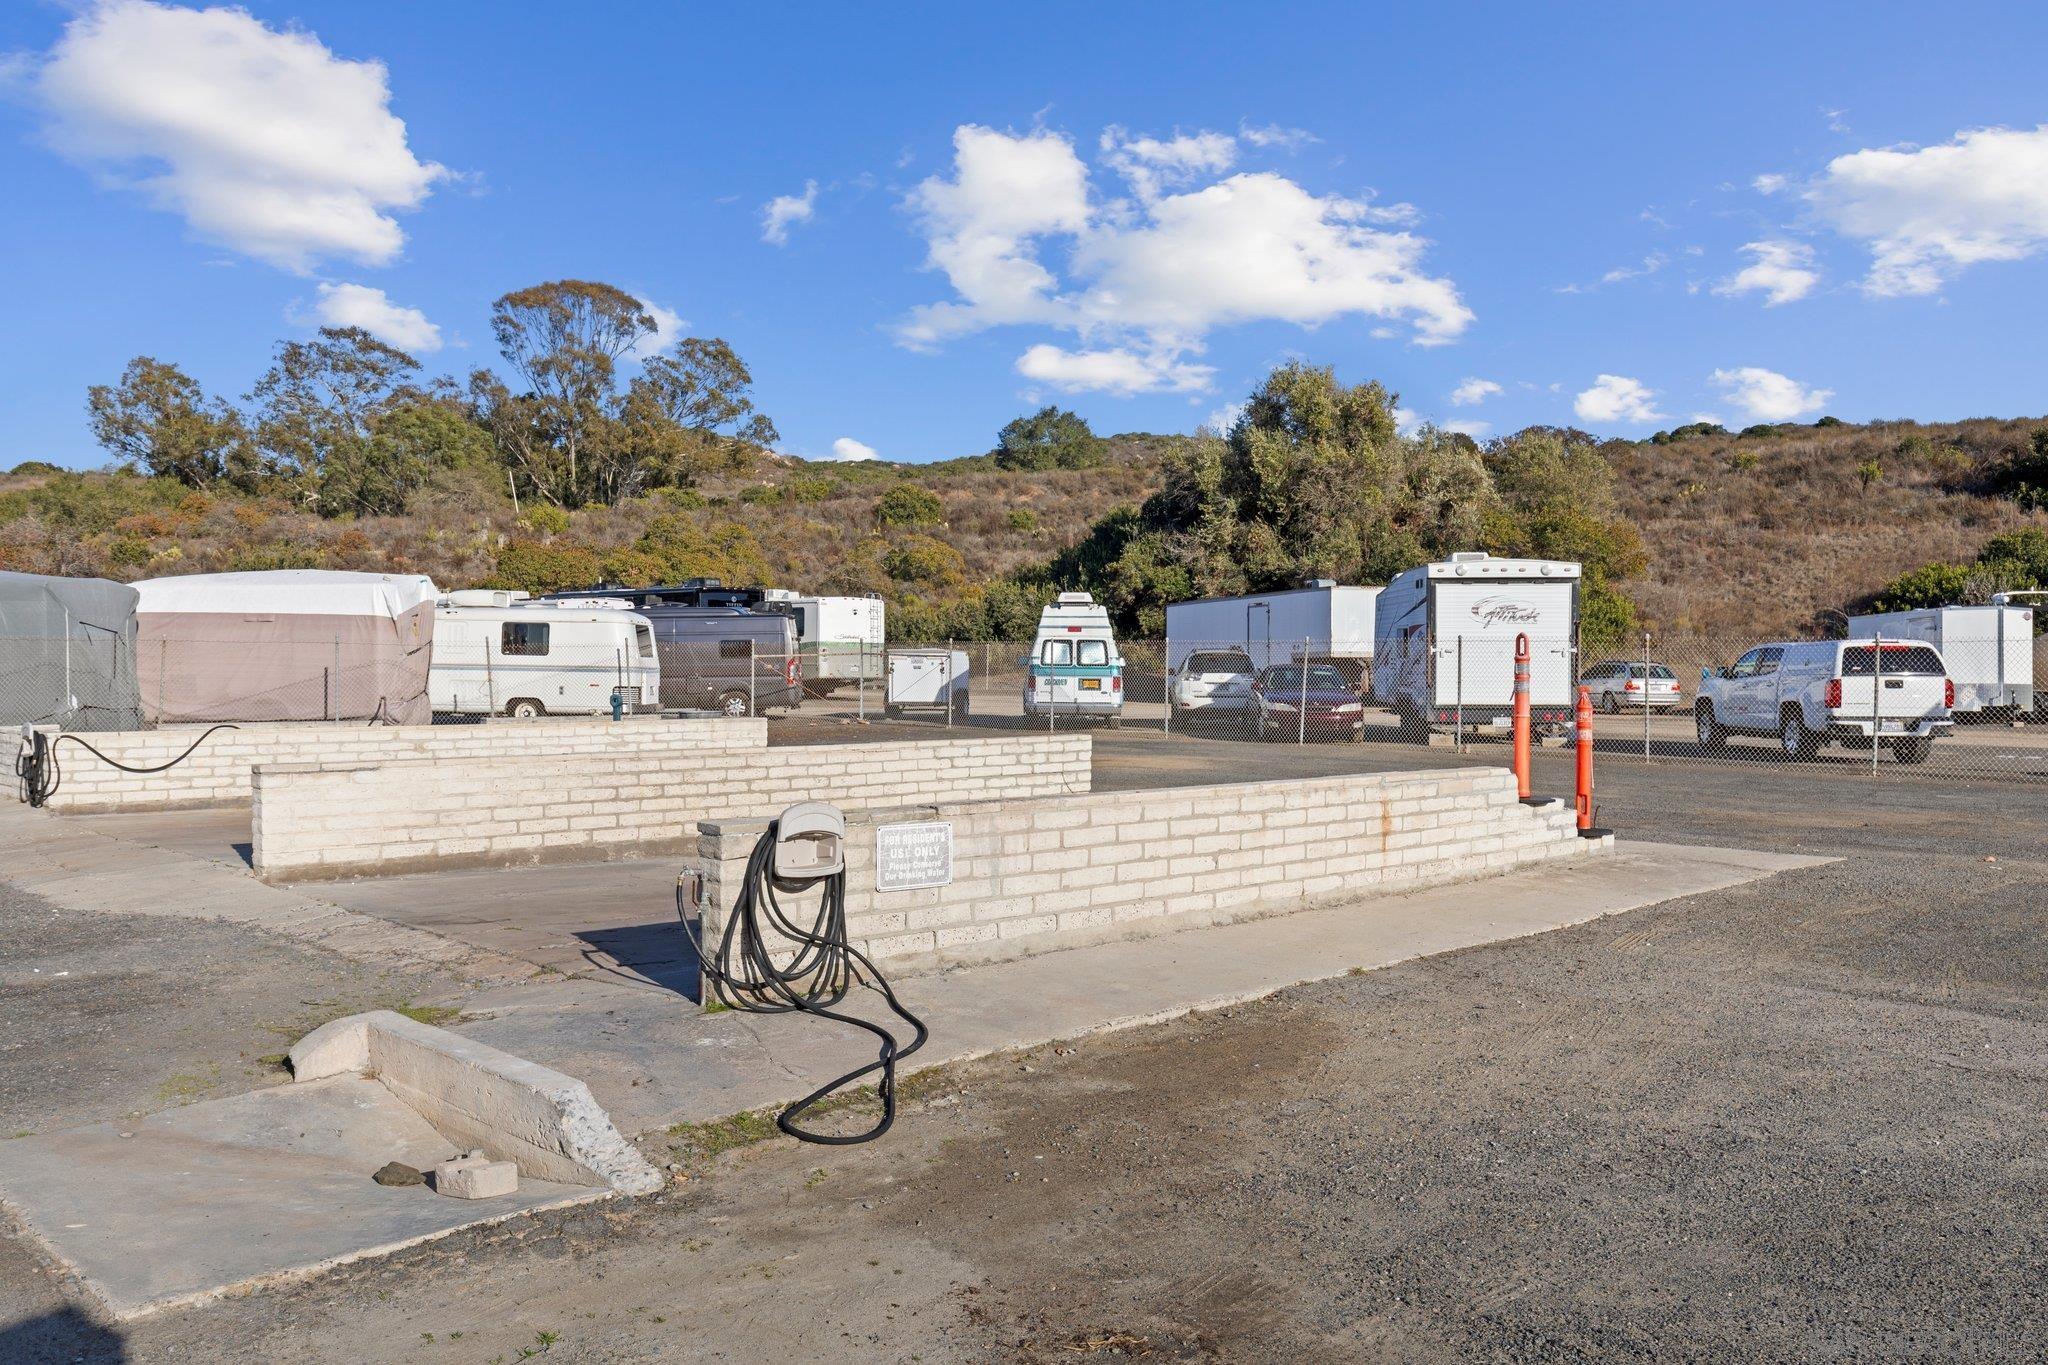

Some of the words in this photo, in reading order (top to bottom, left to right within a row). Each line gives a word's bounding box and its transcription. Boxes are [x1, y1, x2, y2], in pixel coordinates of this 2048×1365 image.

[884, 833, 900, 845] FOR
[890, 847, 911, 859] USE
[914, 845, 940, 857] ONLY
